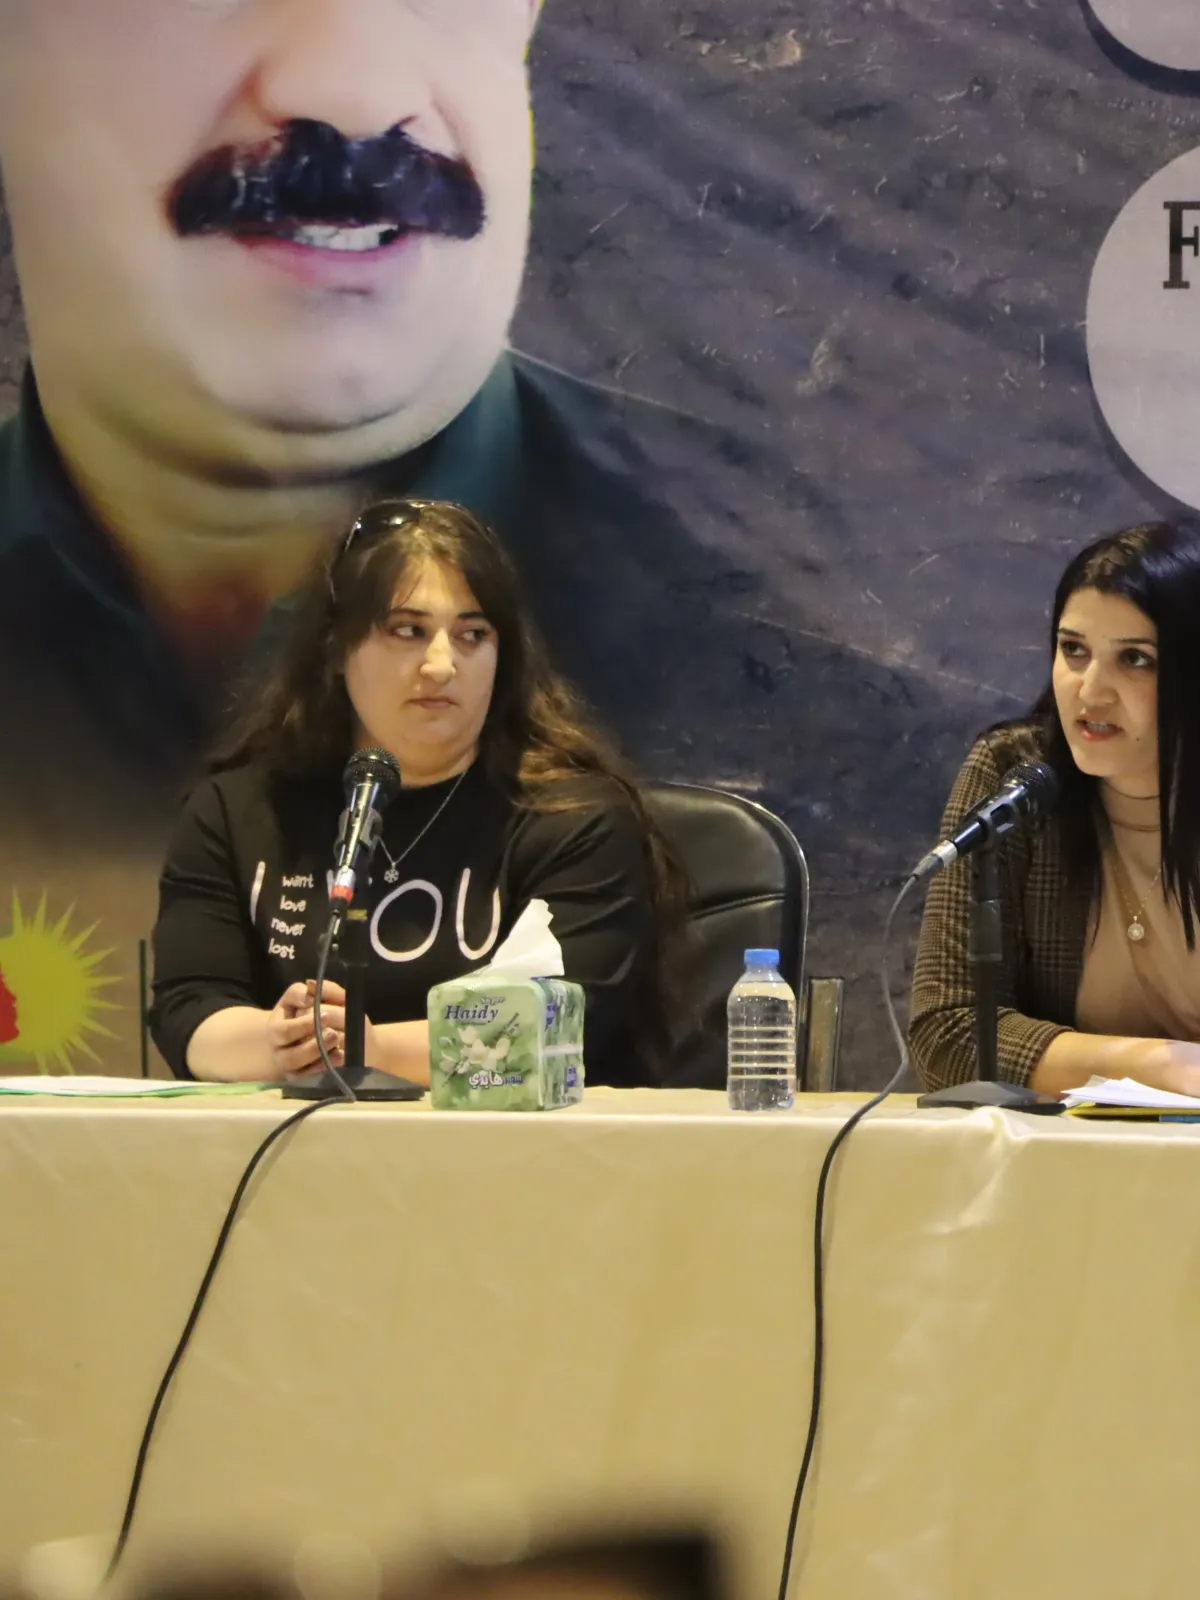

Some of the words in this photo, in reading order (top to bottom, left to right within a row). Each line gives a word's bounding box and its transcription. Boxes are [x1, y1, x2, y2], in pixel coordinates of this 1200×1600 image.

[282, 874, 314, 889] want
[280, 895, 306, 912] love
[326, 868, 501, 962] OU
[271, 917, 306, 936] never
[268, 938, 295, 960] lost
[445, 1004, 498, 1023] Haidy
